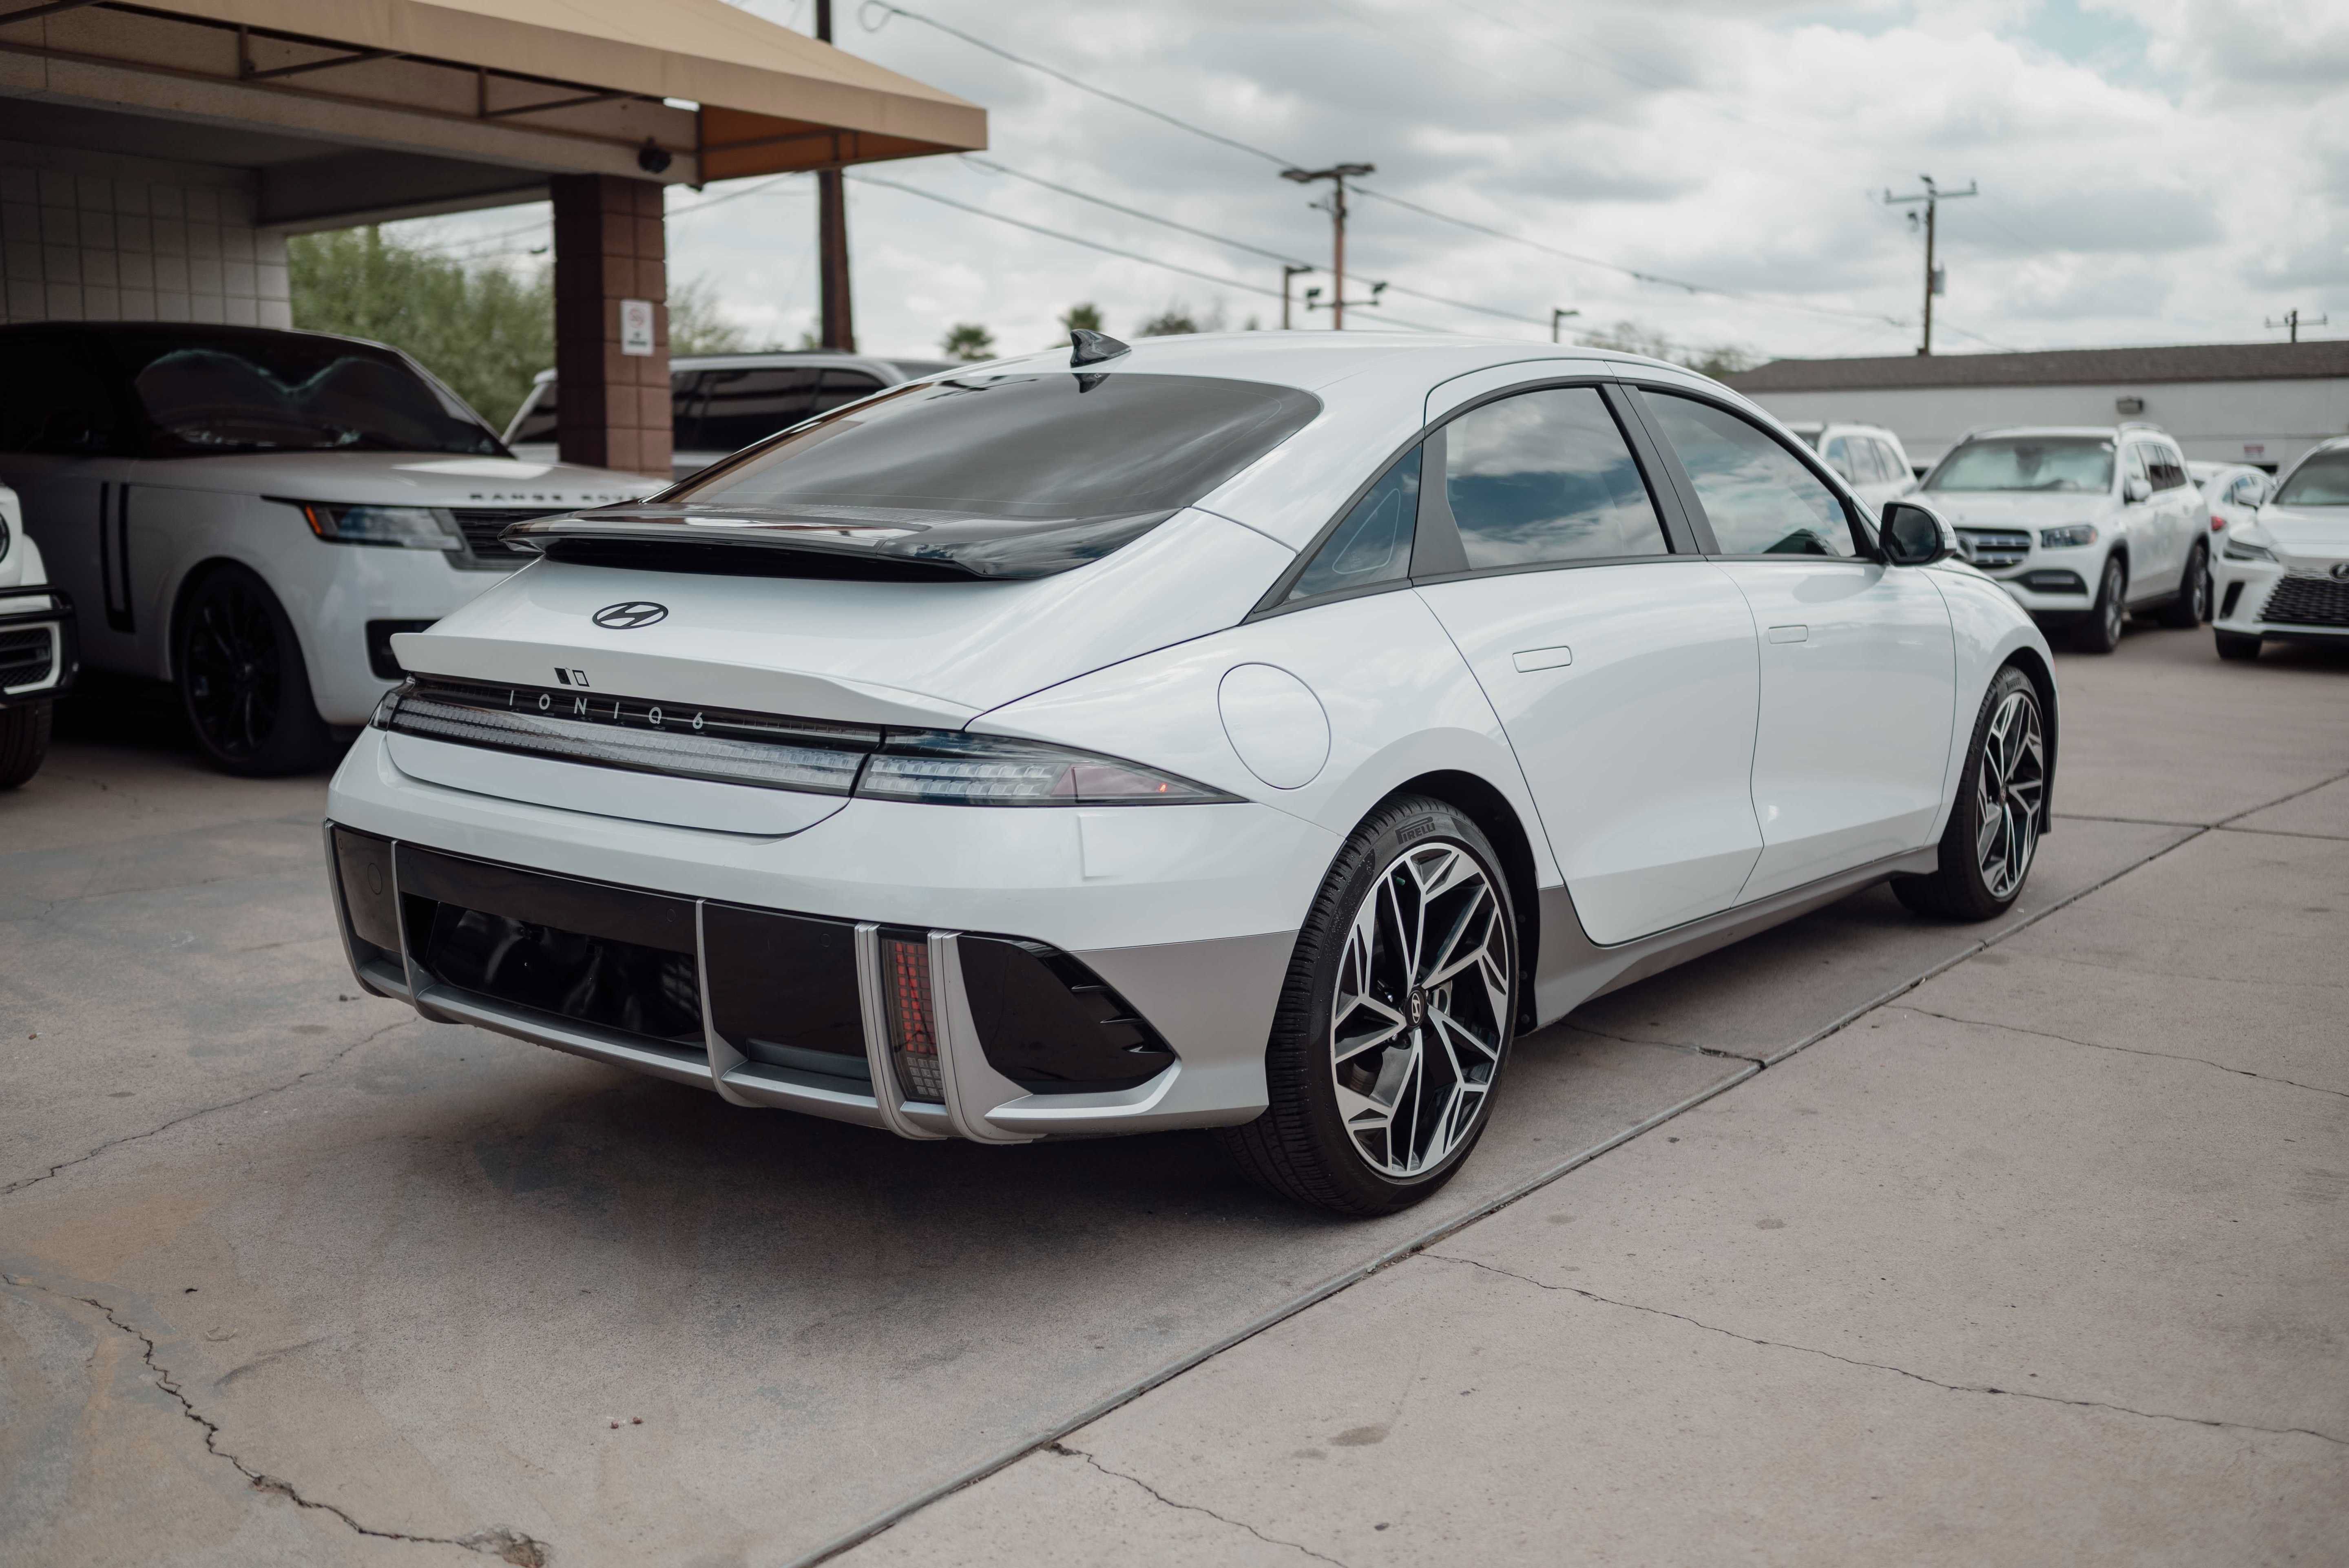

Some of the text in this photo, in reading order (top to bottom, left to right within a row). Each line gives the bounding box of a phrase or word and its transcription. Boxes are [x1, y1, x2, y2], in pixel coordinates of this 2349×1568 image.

[509, 690, 703, 730] IONIQ 6
[1395, 816, 1436, 845] PIRELLI
